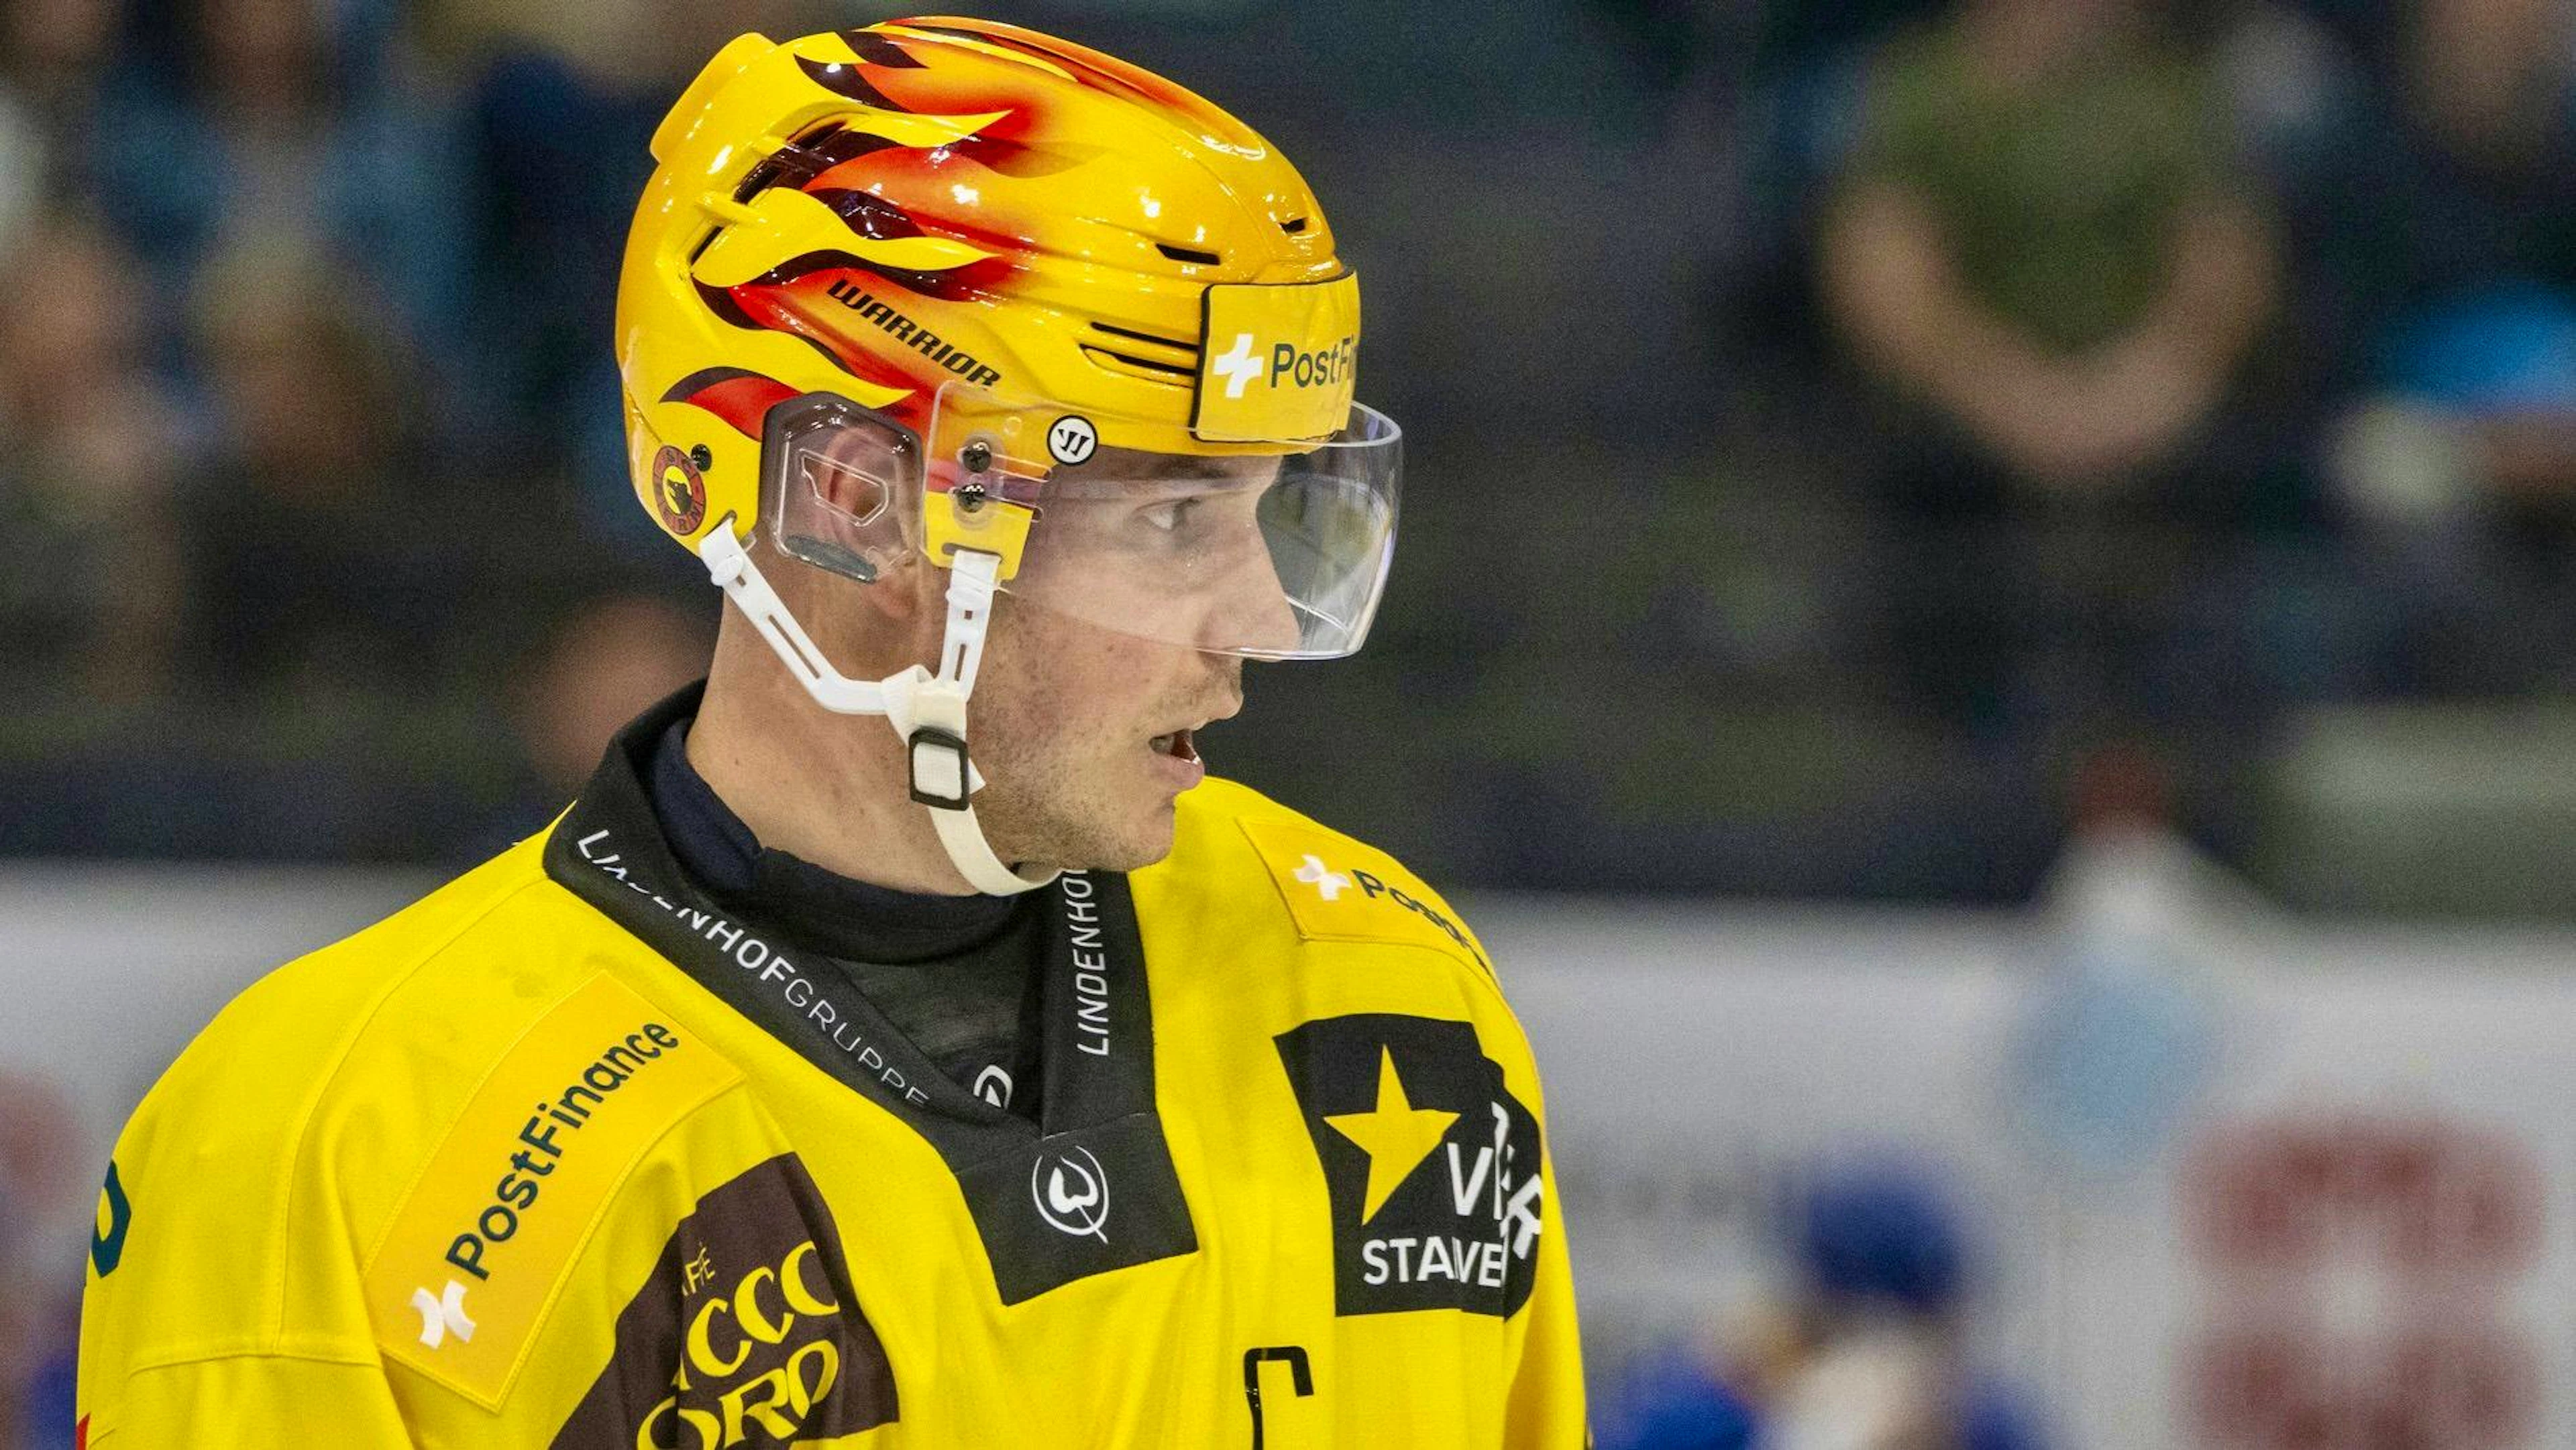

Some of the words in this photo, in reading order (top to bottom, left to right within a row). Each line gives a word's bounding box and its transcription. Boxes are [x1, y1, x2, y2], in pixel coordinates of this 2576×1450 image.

[826, 279, 1001, 391] WARRIOR
[1061, 868, 1108, 1055] LINDENHO
[445, 1023, 679, 1282] PostFinance
